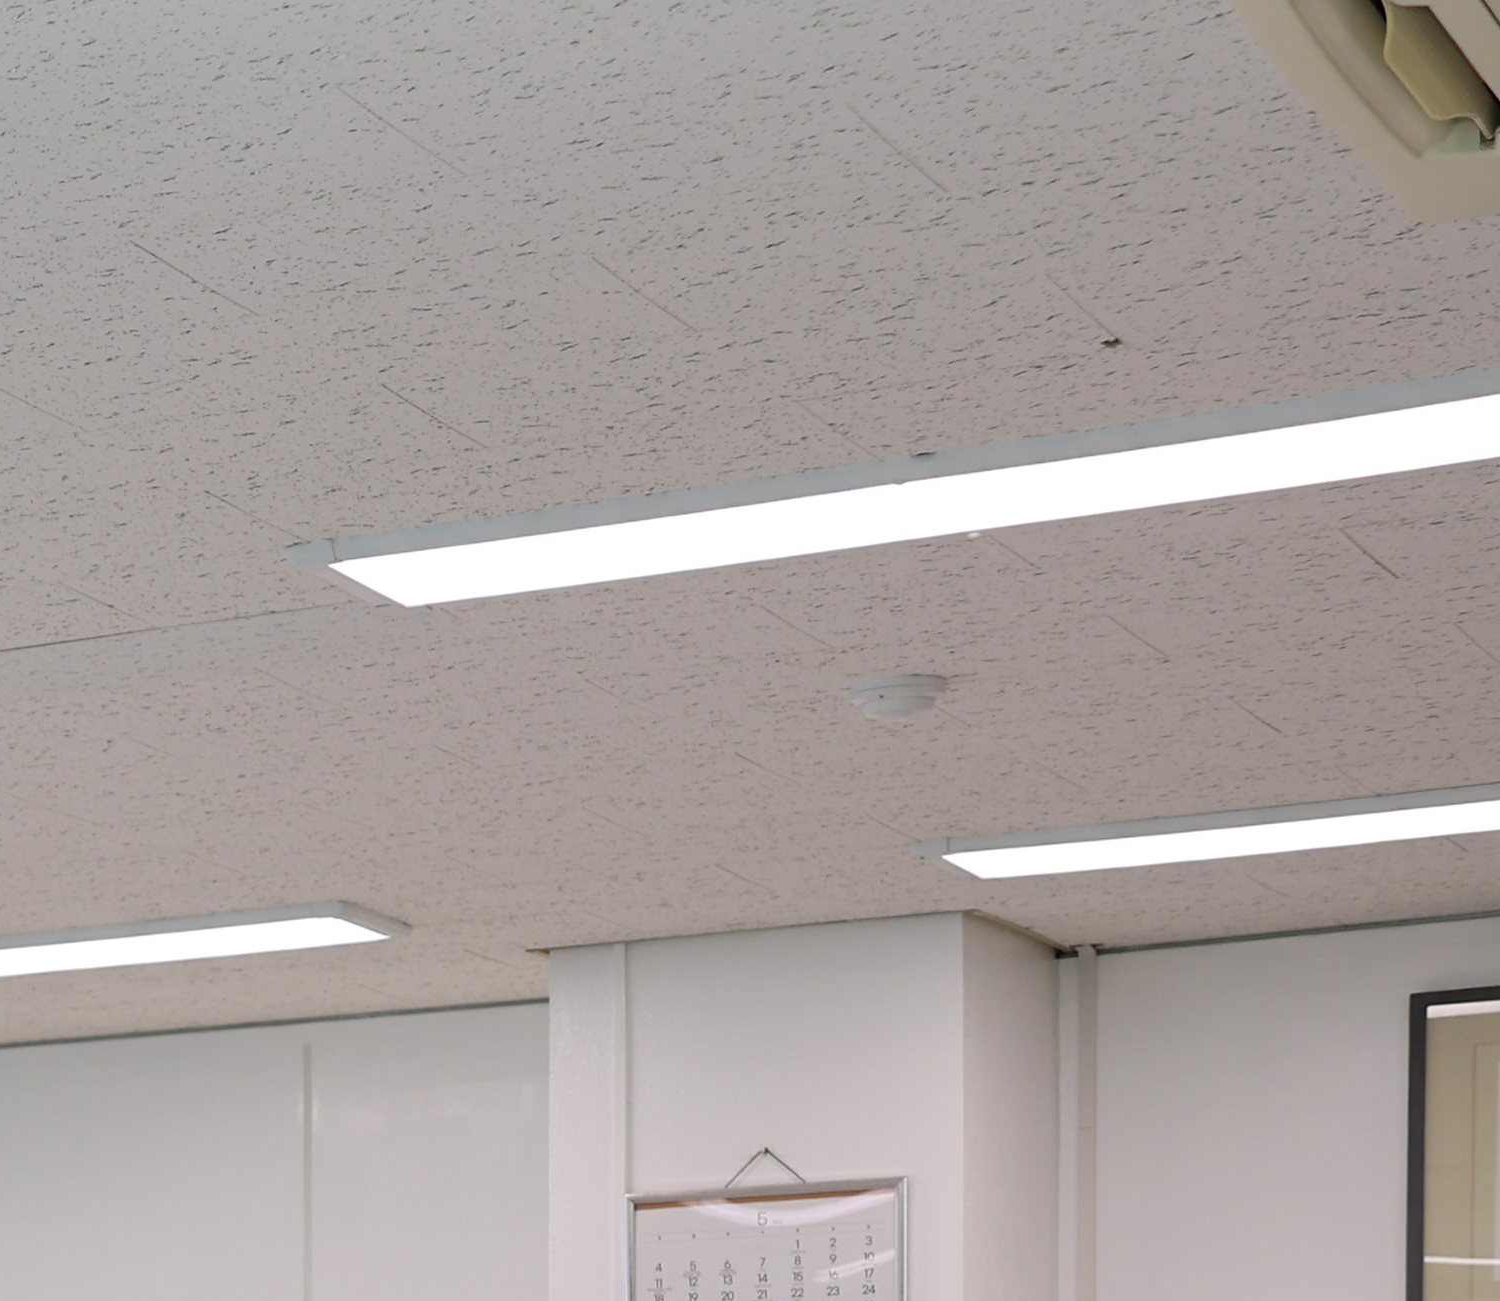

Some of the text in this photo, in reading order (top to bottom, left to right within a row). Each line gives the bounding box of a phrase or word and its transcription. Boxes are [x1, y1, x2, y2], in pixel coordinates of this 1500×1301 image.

[757, 1211, 768, 1226] 5
[829, 1237, 837, 1248] 2
[865, 1235, 873, 1246] 3
[655, 1263, 663, 1272] 4
[689, 1260, 697, 1272] 5
[723, 1260, 732, 1270] 6
[759, 1257, 766, 1267] 7
[794, 1255, 802, 1266] 8
[829, 1253, 837, 1264] 9
[655, 1278, 663, 1289] 11
[688, 1276, 698, 1287] 12
[722, 1274, 733, 1285] 13
[757, 1273, 768, 1283] 14
[792, 1271, 804, 1282] 15
[864, 1267, 875, 1279] 17
[721, 1291, 735, 1301] 20
[757, 1289, 768, 1300] 21
[791, 1287, 804, 1298] 22
[826, 1285, 840, 1297] 23
[862, 1284, 876, 1295] 24
